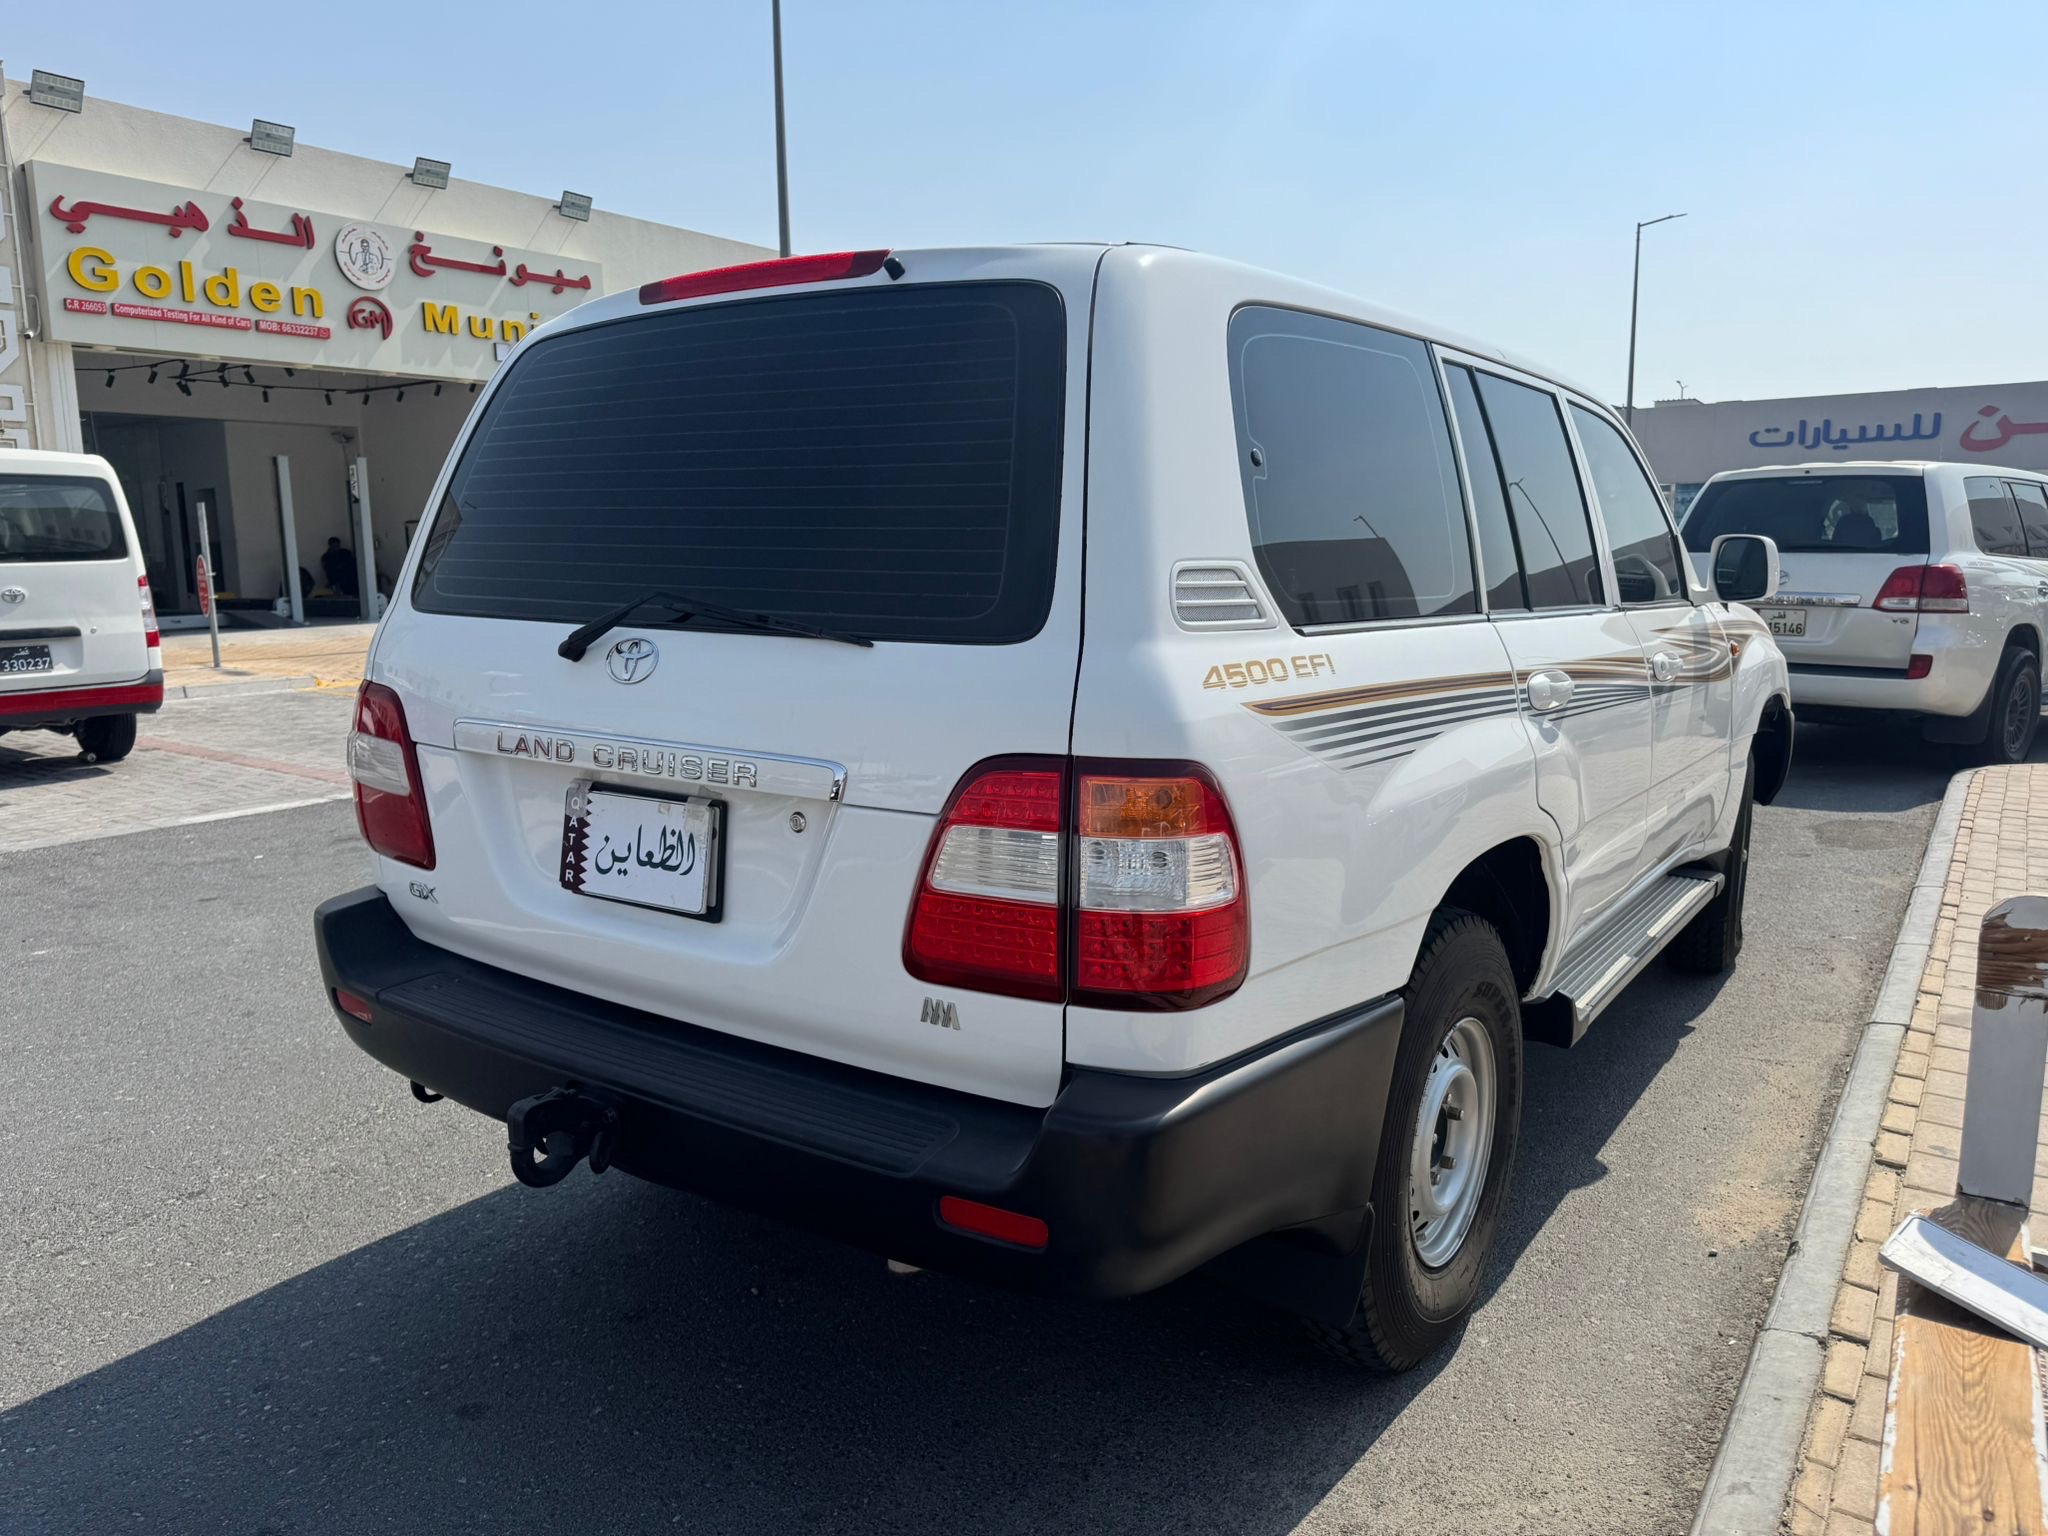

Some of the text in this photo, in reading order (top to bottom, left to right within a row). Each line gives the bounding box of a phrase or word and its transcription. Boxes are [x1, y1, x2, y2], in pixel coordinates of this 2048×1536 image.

[50, 194, 315, 250] الذهبي
[67, 246, 324, 318] Golden
[81, 301, 106, 313] 266053
[114, 304, 162, 317] Computerized
[163, 309, 188, 322] Testing
[189, 312, 200, 321] For
[201, 313, 211, 322] All
[211, 315, 227, 325] Kind
[228, 316, 235, 325] of
[235, 318, 251, 328] Cars
[260, 321, 280, 332] MOB:
[282, 323, 318, 335] 66332237
[1749, 412, 1942, 449] للسيارات
[1, 657, 50, 672] 330237
[1202, 653, 1336, 689] 4500 EFI
[496, 731, 759, 788] LAND CRUISER
[565, 797, 581, 883] QATAR
[408, 880, 439, 905] GX
